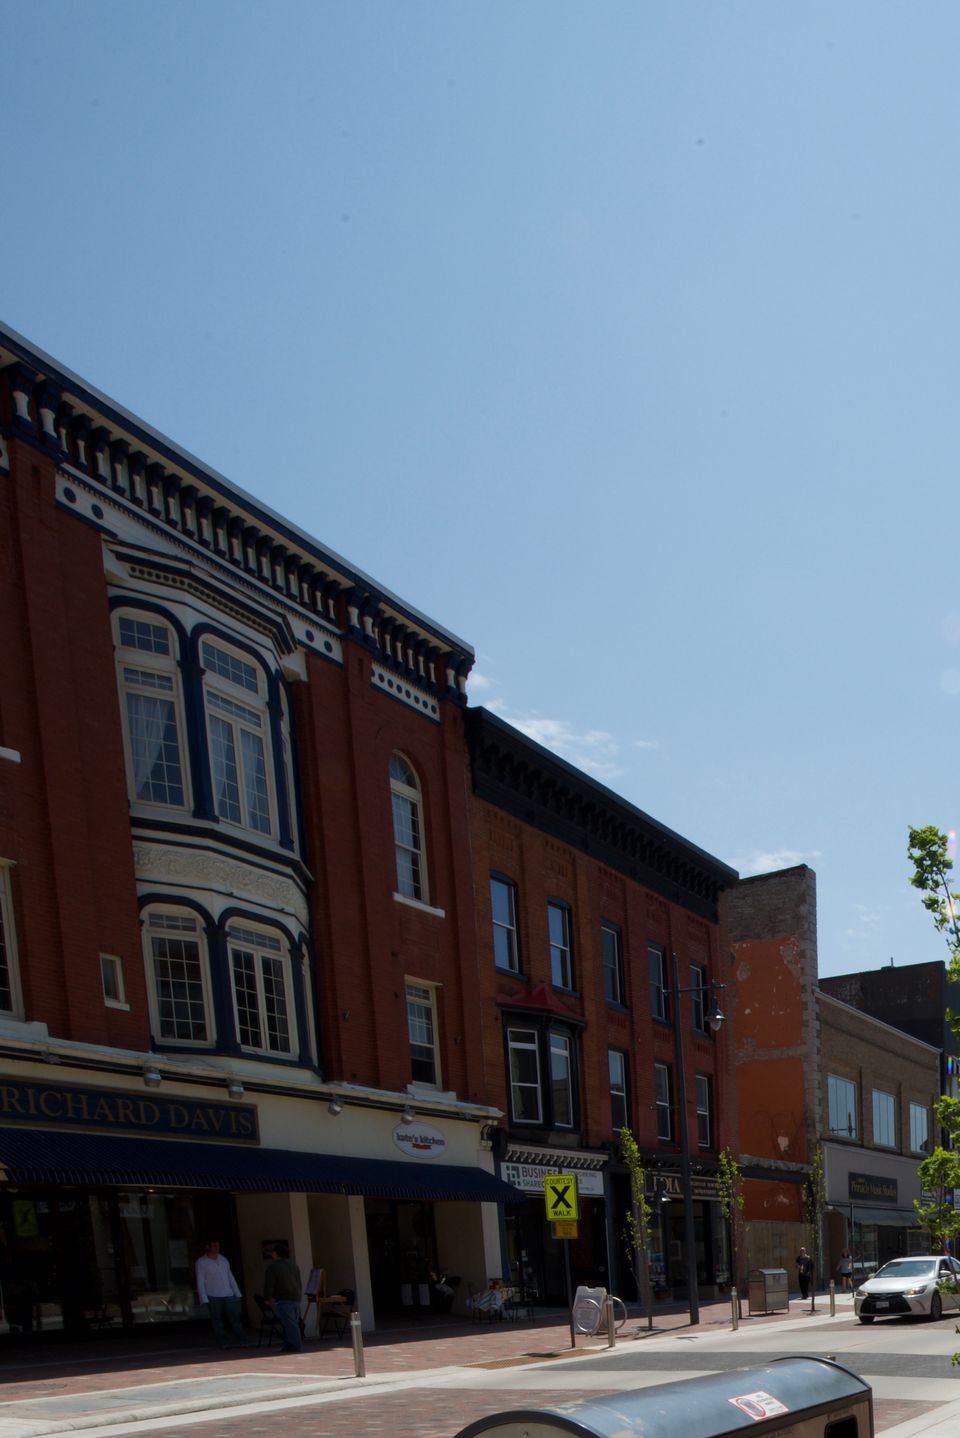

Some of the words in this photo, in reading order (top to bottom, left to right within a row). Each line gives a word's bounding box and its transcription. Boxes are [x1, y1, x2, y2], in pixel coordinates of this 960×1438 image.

[0, 1087, 160, 1125] RICHARD
[168, 1104, 253, 1135] DAVIS
[545, 1177, 574, 1186] COURTESY
[552, 1209, 571, 1217] WALK
